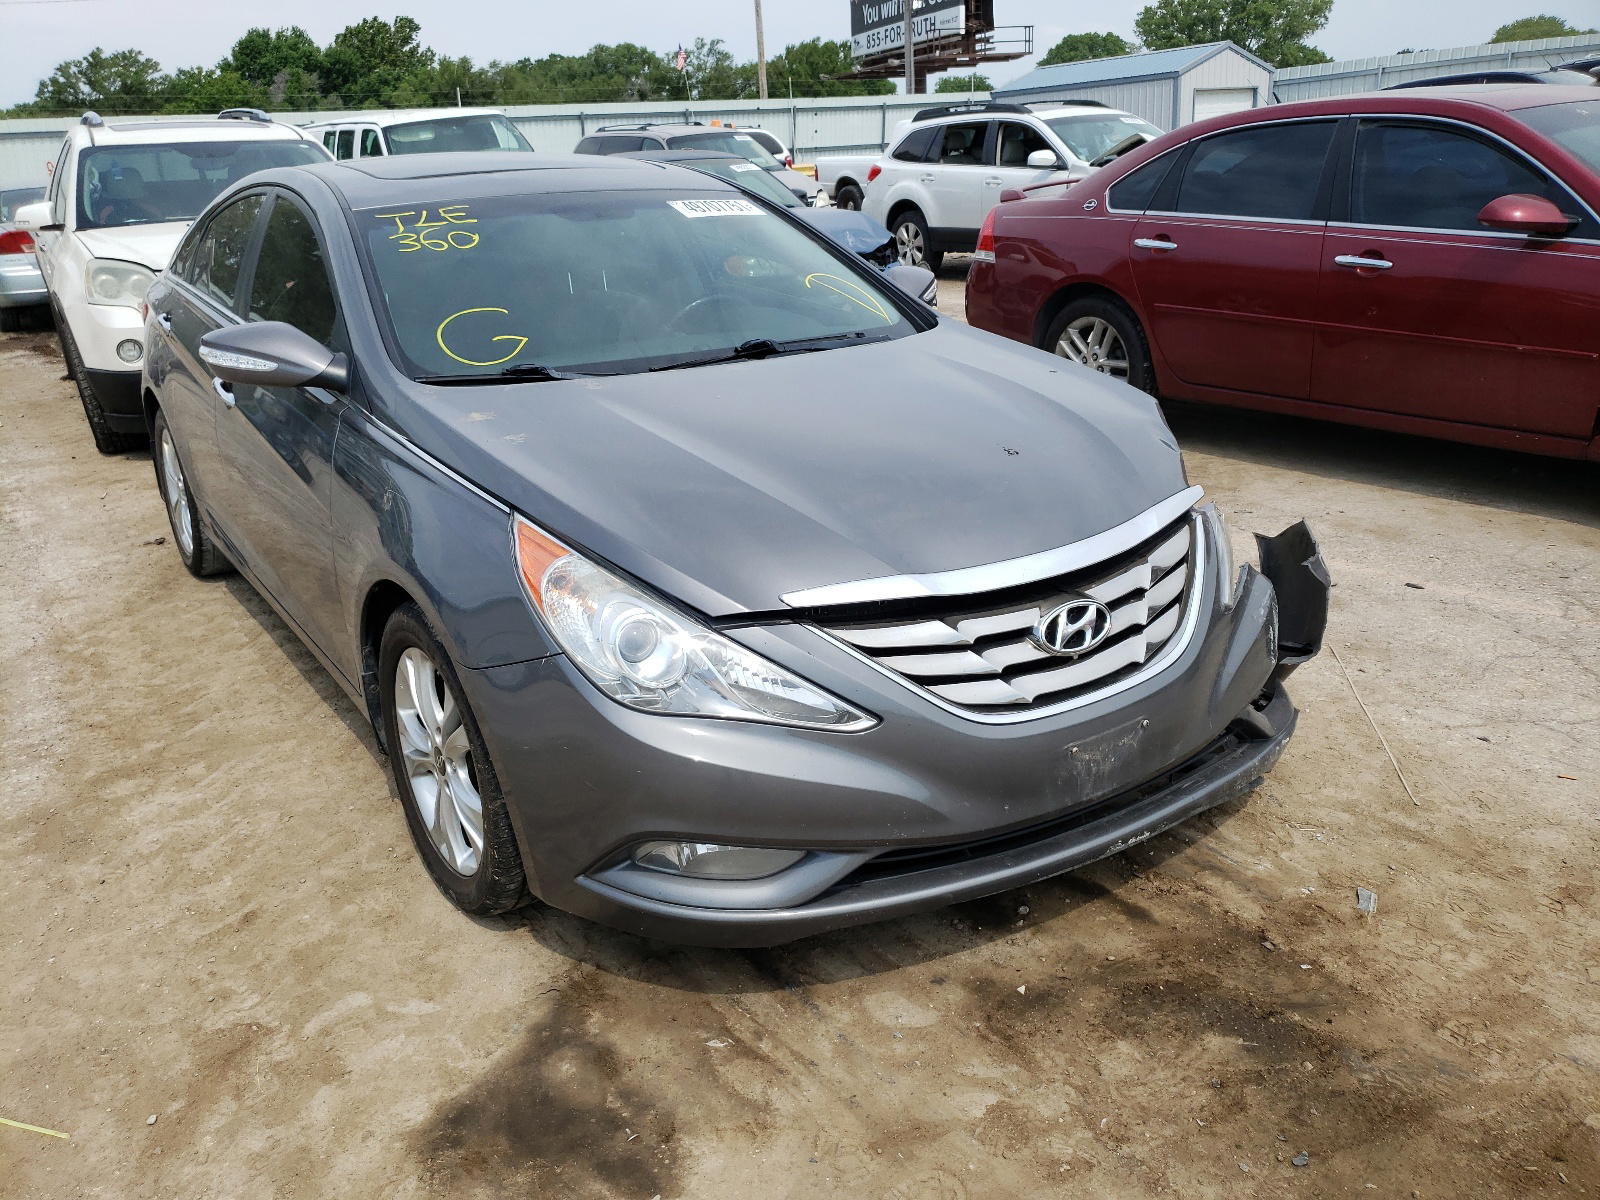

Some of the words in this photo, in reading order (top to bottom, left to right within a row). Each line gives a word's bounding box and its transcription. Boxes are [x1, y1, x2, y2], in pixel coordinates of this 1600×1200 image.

[862, 4, 879, 25] You
[866, 16, 936, 49] 855-FOR-RUTH
[375, 205, 478, 233] TLE
[388, 226, 480, 252] 360
[436, 307, 529, 366] G
